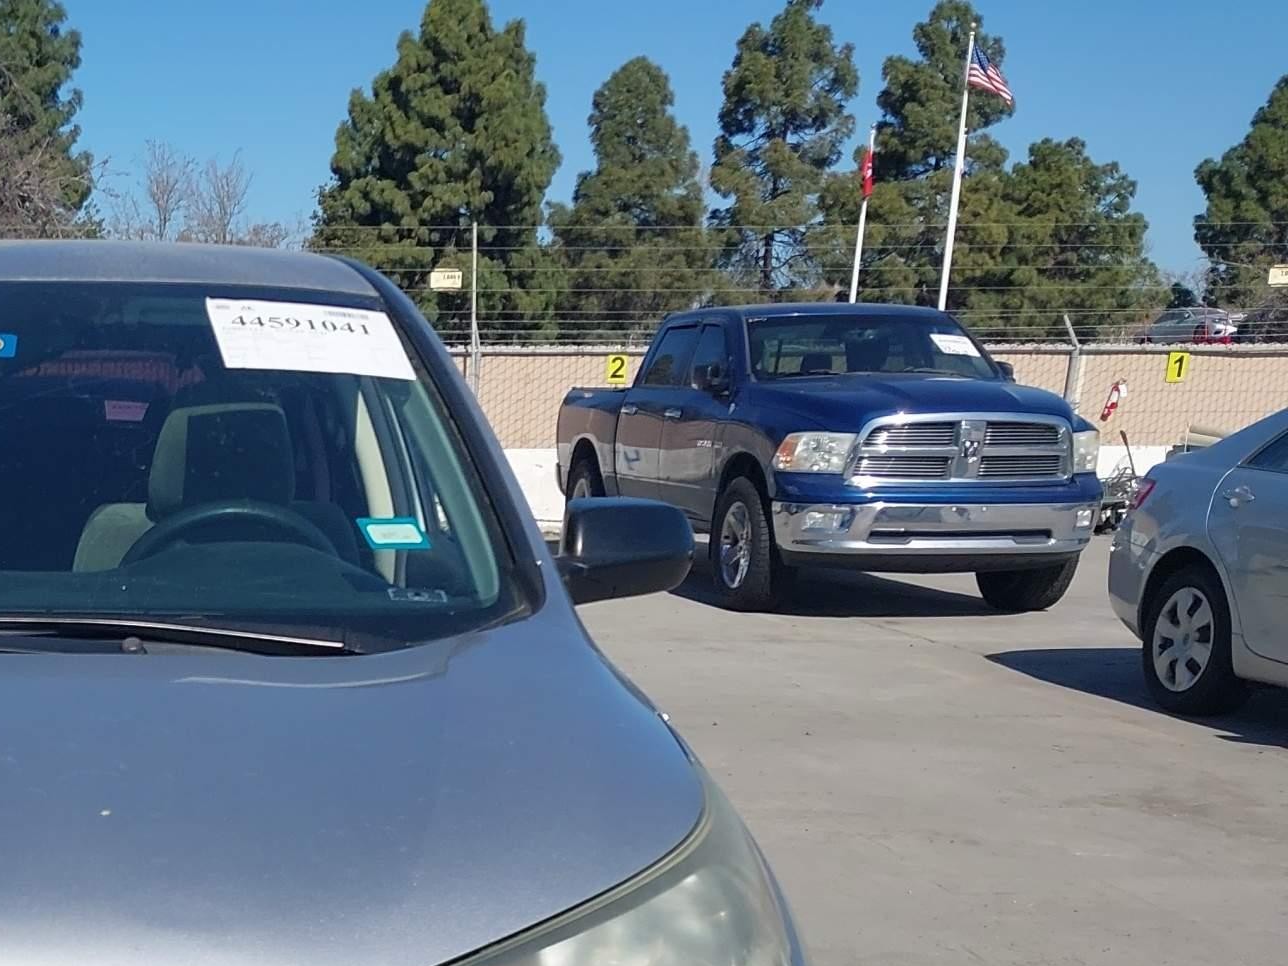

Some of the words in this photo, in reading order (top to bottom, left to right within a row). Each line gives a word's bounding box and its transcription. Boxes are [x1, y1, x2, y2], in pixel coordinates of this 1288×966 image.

[231, 315, 370, 336] 44591041
[610, 356, 625, 379] 2
[1174, 355, 1185, 378] 1
